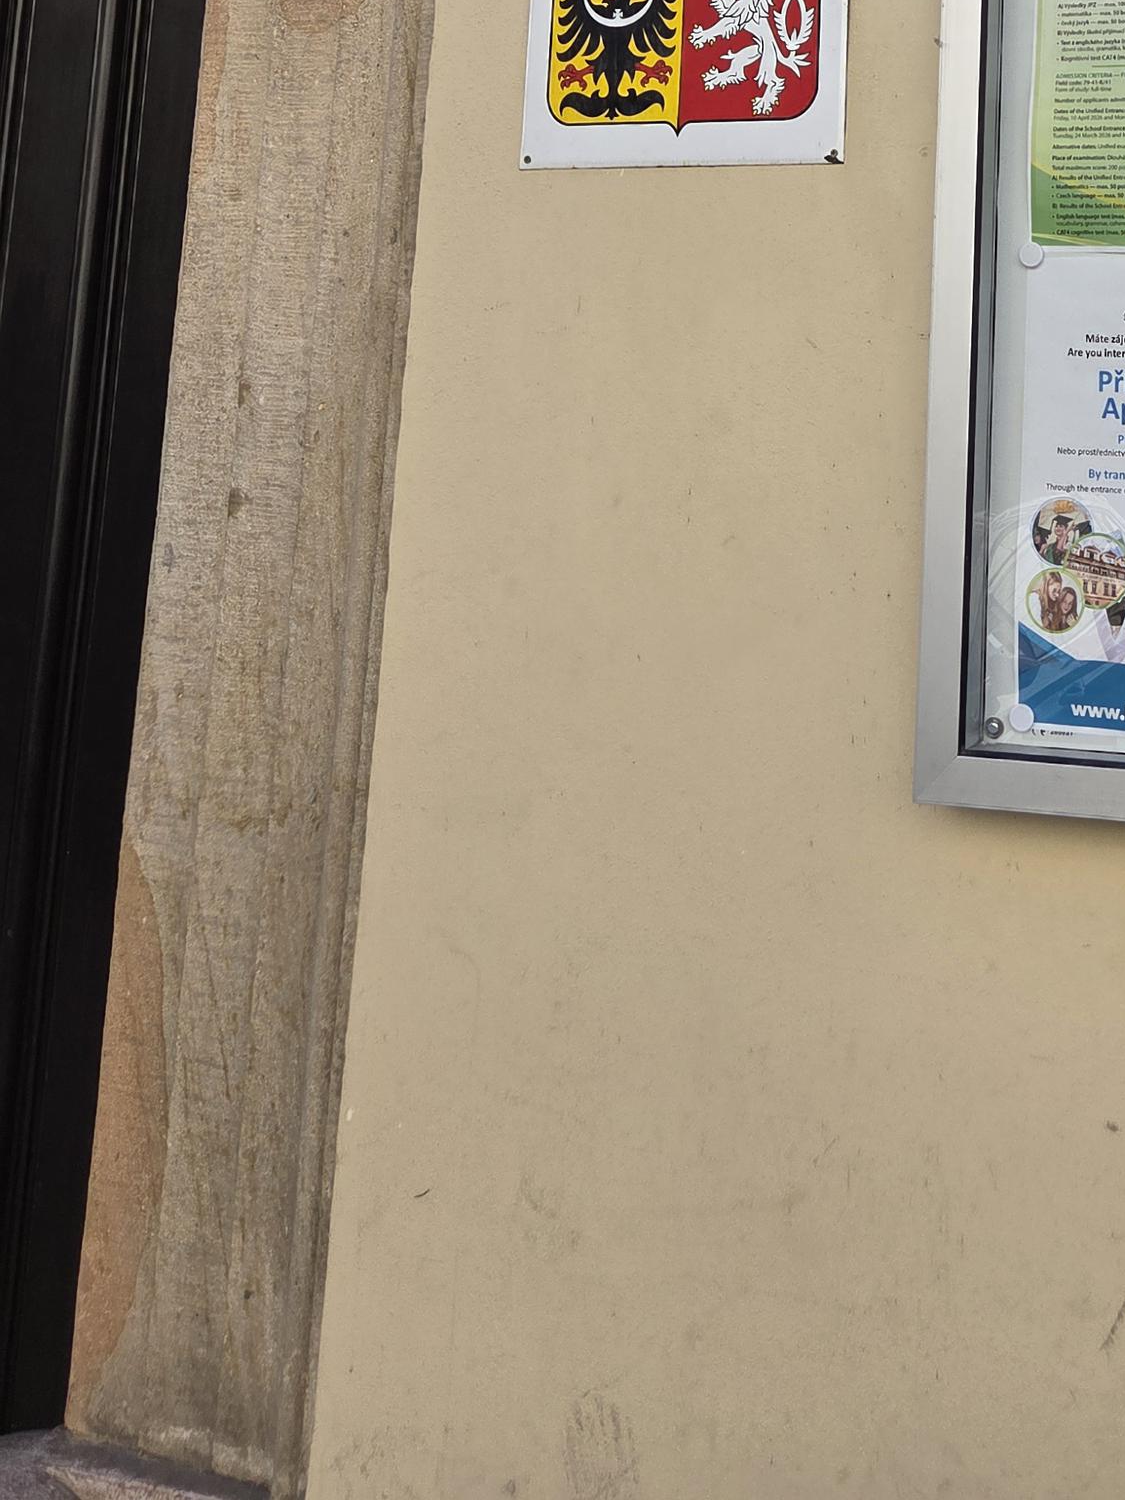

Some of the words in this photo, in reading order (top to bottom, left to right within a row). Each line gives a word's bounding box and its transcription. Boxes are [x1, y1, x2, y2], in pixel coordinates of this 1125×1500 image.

[1086, 334, 1109, 343] Máte
[1067, 348, 1083, 357] Are
[1085, 350, 1101, 359] you
[1057, 447, 1076, 455] Nebo
[1088, 469, 1101, 481] By
[1046, 483, 1075, 493] Through
[1077, 484, 1088, 492] the
[1091, 486, 1122, 494] entrance
